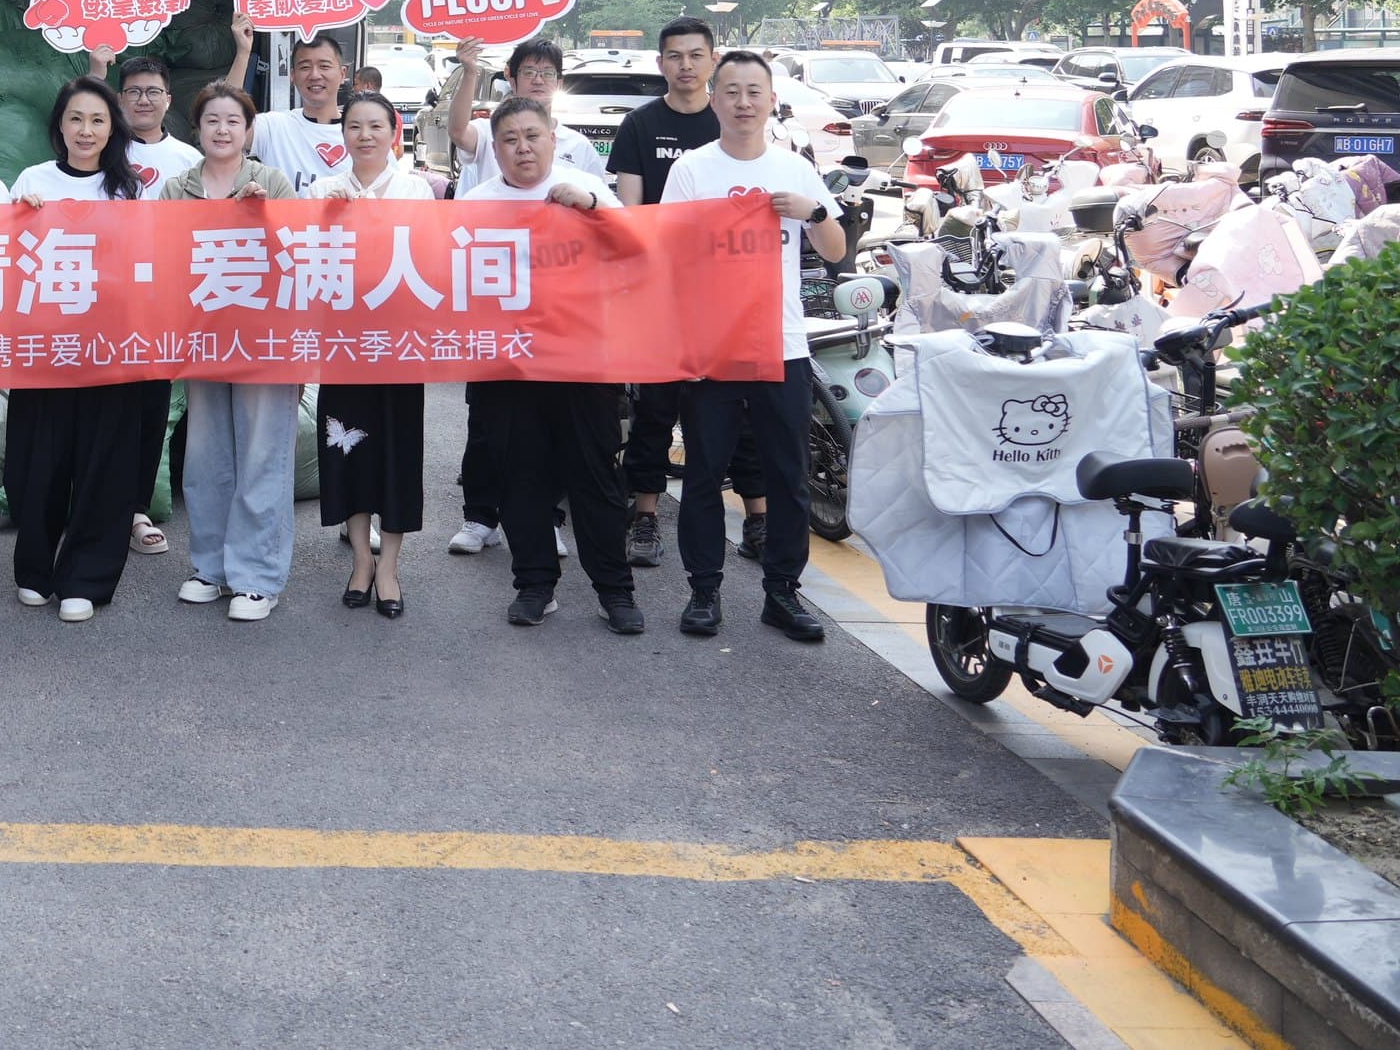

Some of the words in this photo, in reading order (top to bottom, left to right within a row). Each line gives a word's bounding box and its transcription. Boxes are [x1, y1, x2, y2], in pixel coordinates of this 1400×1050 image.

[992, 449, 1030, 462] Hello
[1036, 447, 1063, 462] Kitt
[1228, 604, 1303, 625] FR003399
